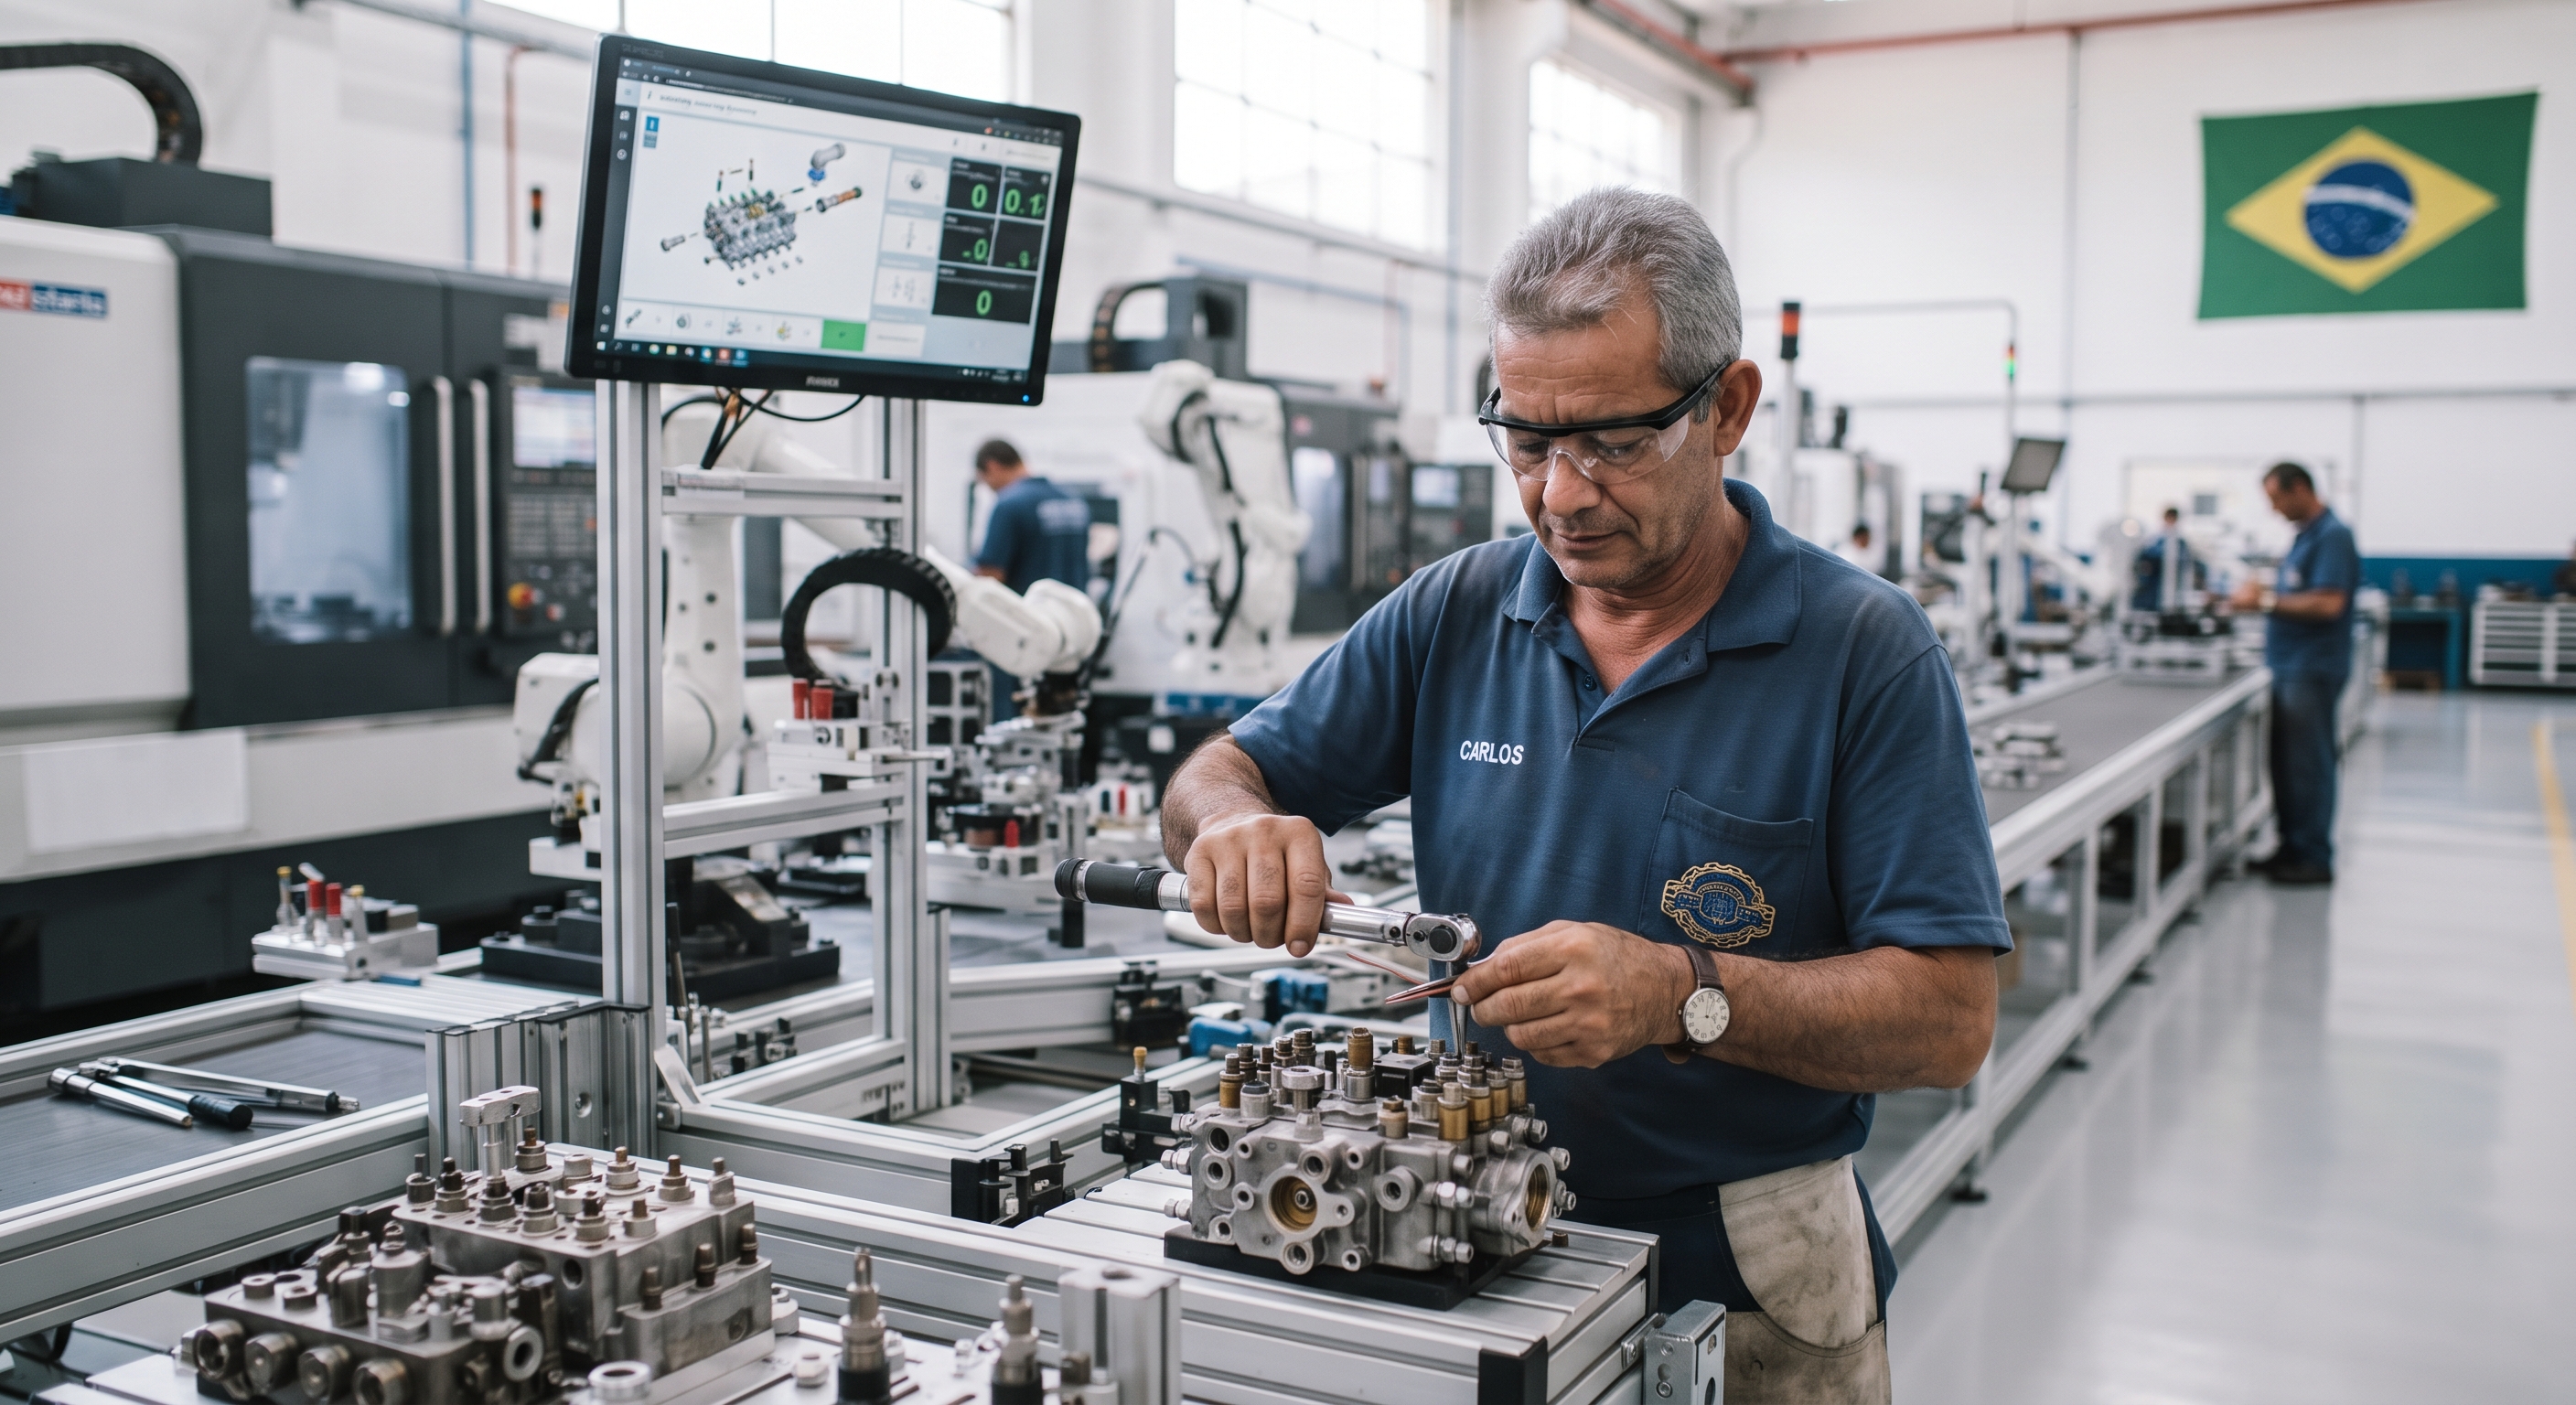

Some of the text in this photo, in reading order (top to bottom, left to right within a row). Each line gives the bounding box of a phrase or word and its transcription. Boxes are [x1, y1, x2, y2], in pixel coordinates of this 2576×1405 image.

[971, 184, 988, 209] 0
[975, 290, 993, 316] 0
[1460, 740, 1525, 766] CARLOS
